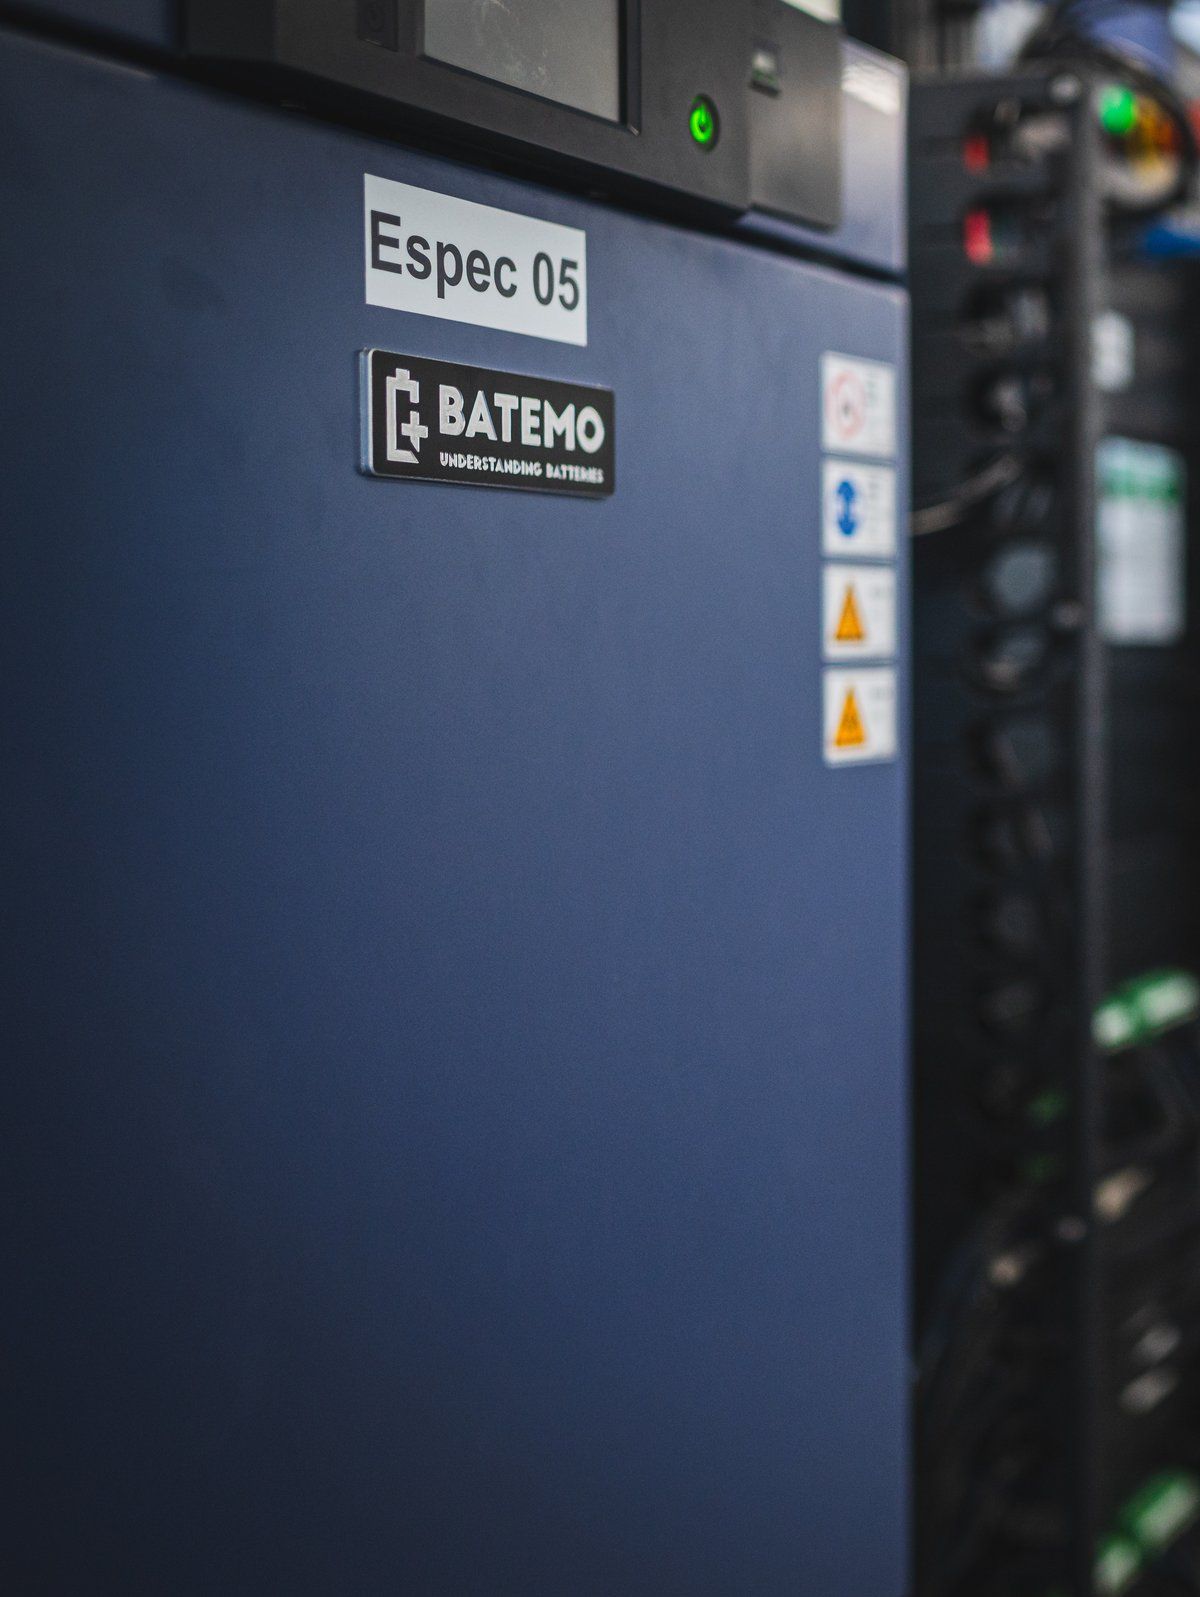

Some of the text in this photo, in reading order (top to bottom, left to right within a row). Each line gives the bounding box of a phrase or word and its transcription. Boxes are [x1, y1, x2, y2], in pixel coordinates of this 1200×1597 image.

[370, 209, 580, 311] Espec 05
[439, 384, 605, 453] BATEMO
[439, 452, 604, 485] UNDERSTANDING BATTERIES
